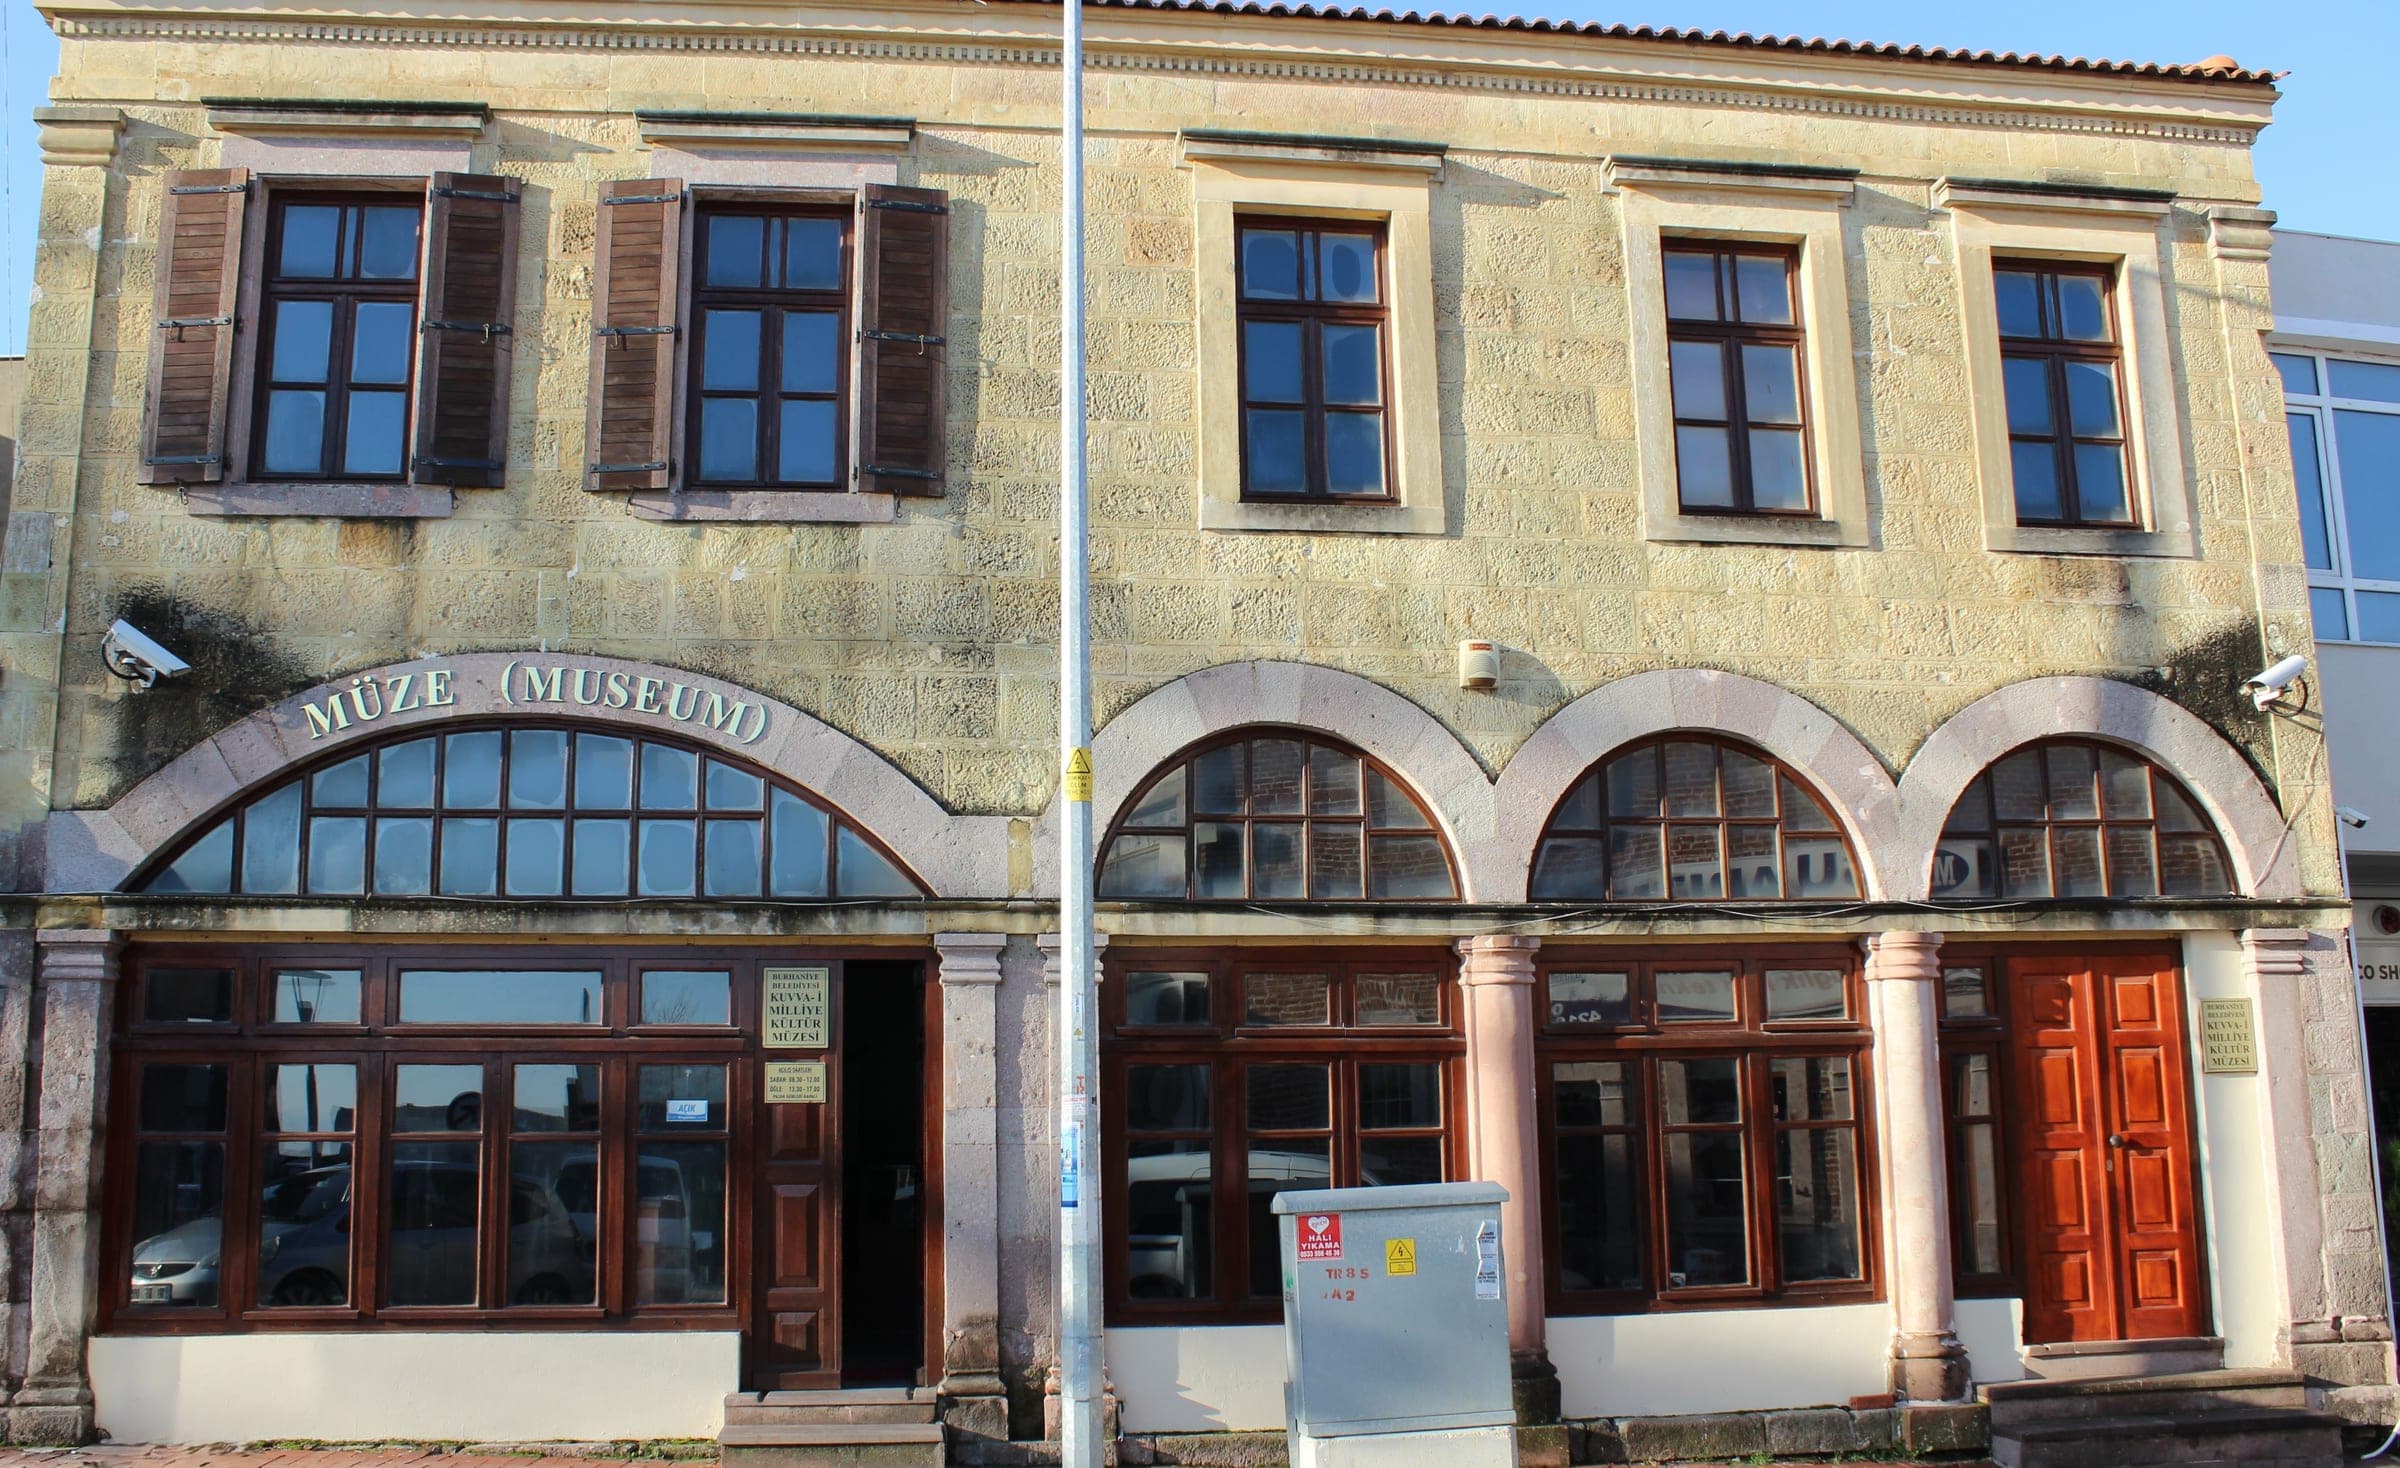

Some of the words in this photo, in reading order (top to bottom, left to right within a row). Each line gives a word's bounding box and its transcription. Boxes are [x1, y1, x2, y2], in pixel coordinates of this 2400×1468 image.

[299, 670, 455, 740] MÜZE
[500, 660, 768, 745] (MUSEUM)
[772, 982, 820, 990] BELEDİYESİ
[769, 1003, 823, 1016] MİLLİYE
[771, 1017, 821, 1029] KÜLTÜR
[772, 1030, 820, 1042] MÜZESİ
[2208, 1031, 2249, 1042] MİLLİYE
[2210, 1043, 2250, 1054] KÜLTÜR
[2212, 1055, 2250, 1066] MÜZESİ
[1308, 1234, 1332, 1242] HALI
[1301, 1242, 1340, 1250] YIKAMA
